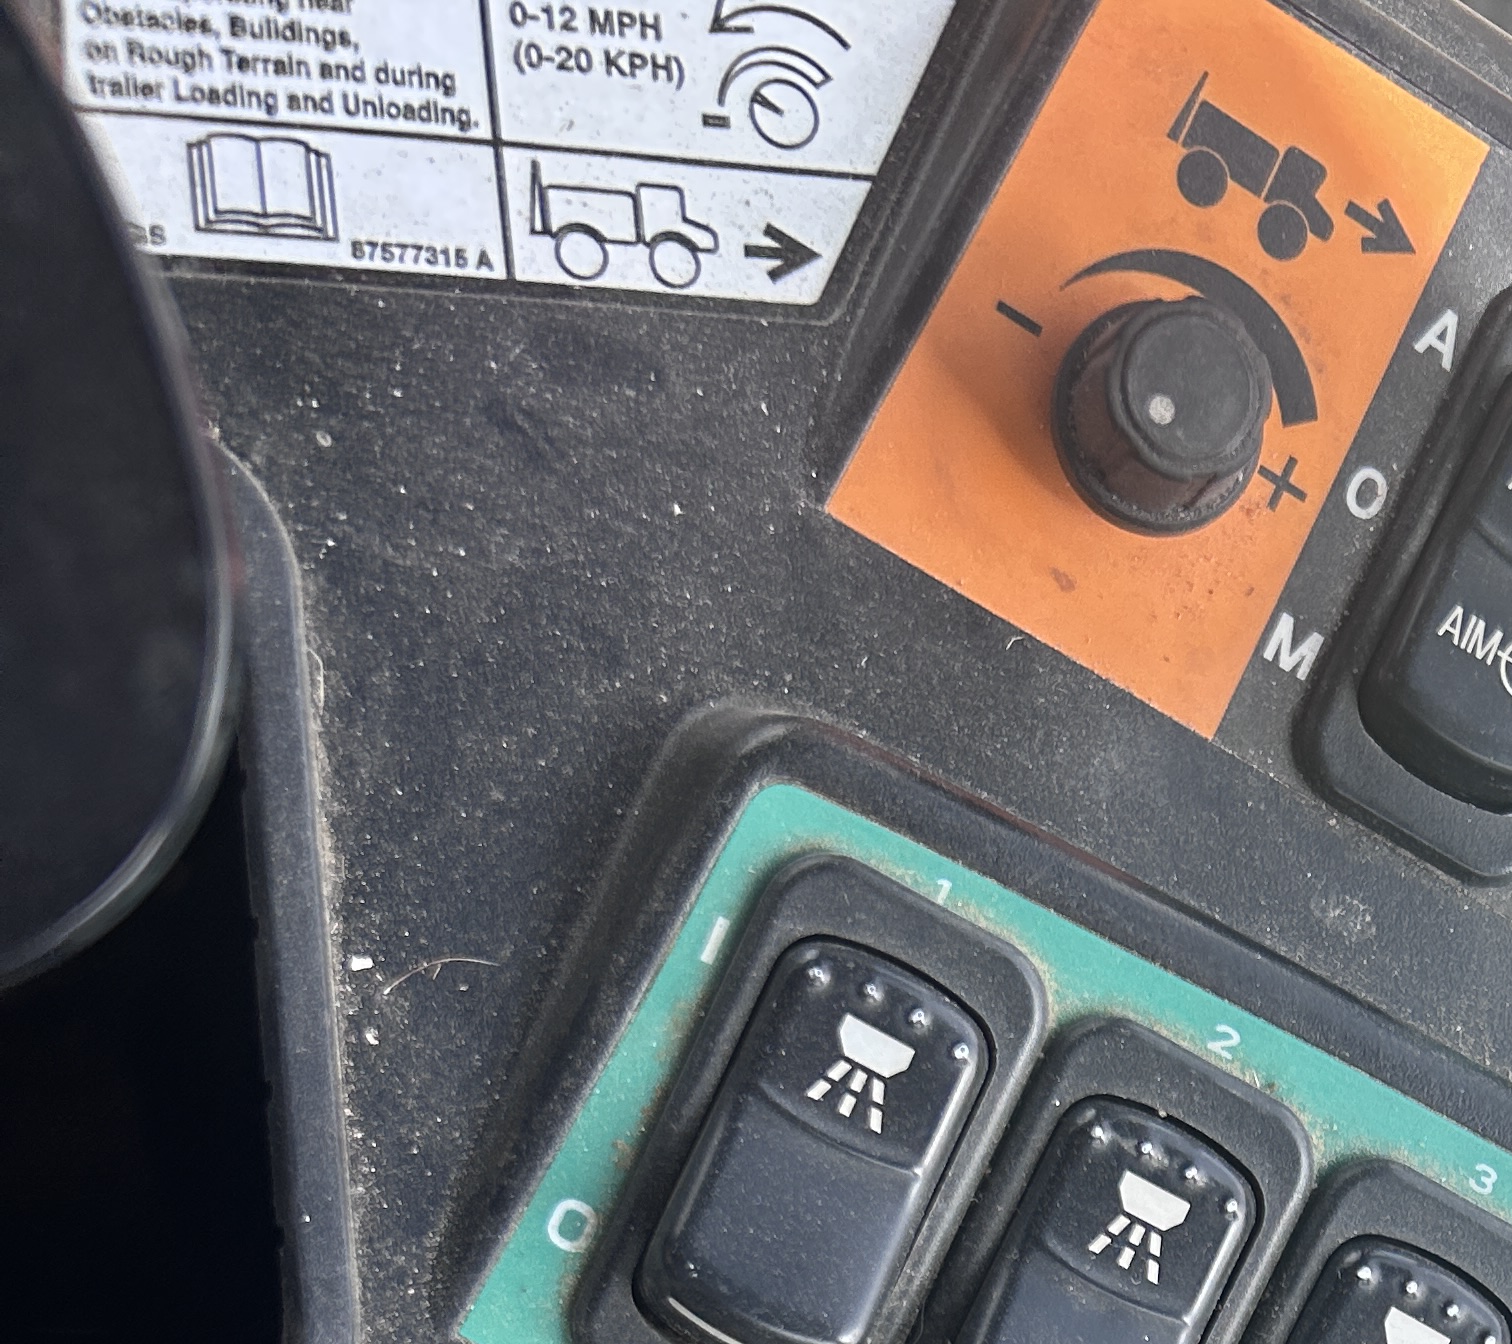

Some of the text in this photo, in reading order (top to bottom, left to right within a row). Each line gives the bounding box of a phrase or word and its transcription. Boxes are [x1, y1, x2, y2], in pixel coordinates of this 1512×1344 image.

[229, 11, 360, 53] Buildings,
[509, 1, 663, 41] 0-12 MPH
[84, 37, 456, 97] on Rough Terrain and during
[513, 39, 686, 91] (0-20 KPH)
[86, 70, 479, 132] trailer Loading and Unloading.
[1414, 308, 1458, 372] A
[1263, 612, 1325, 681] M
[1437, 604, 1504, 667] AIM
[1207, 1024, 1241, 1061] 2
[1468, 1164, 1497, 1197] 3
